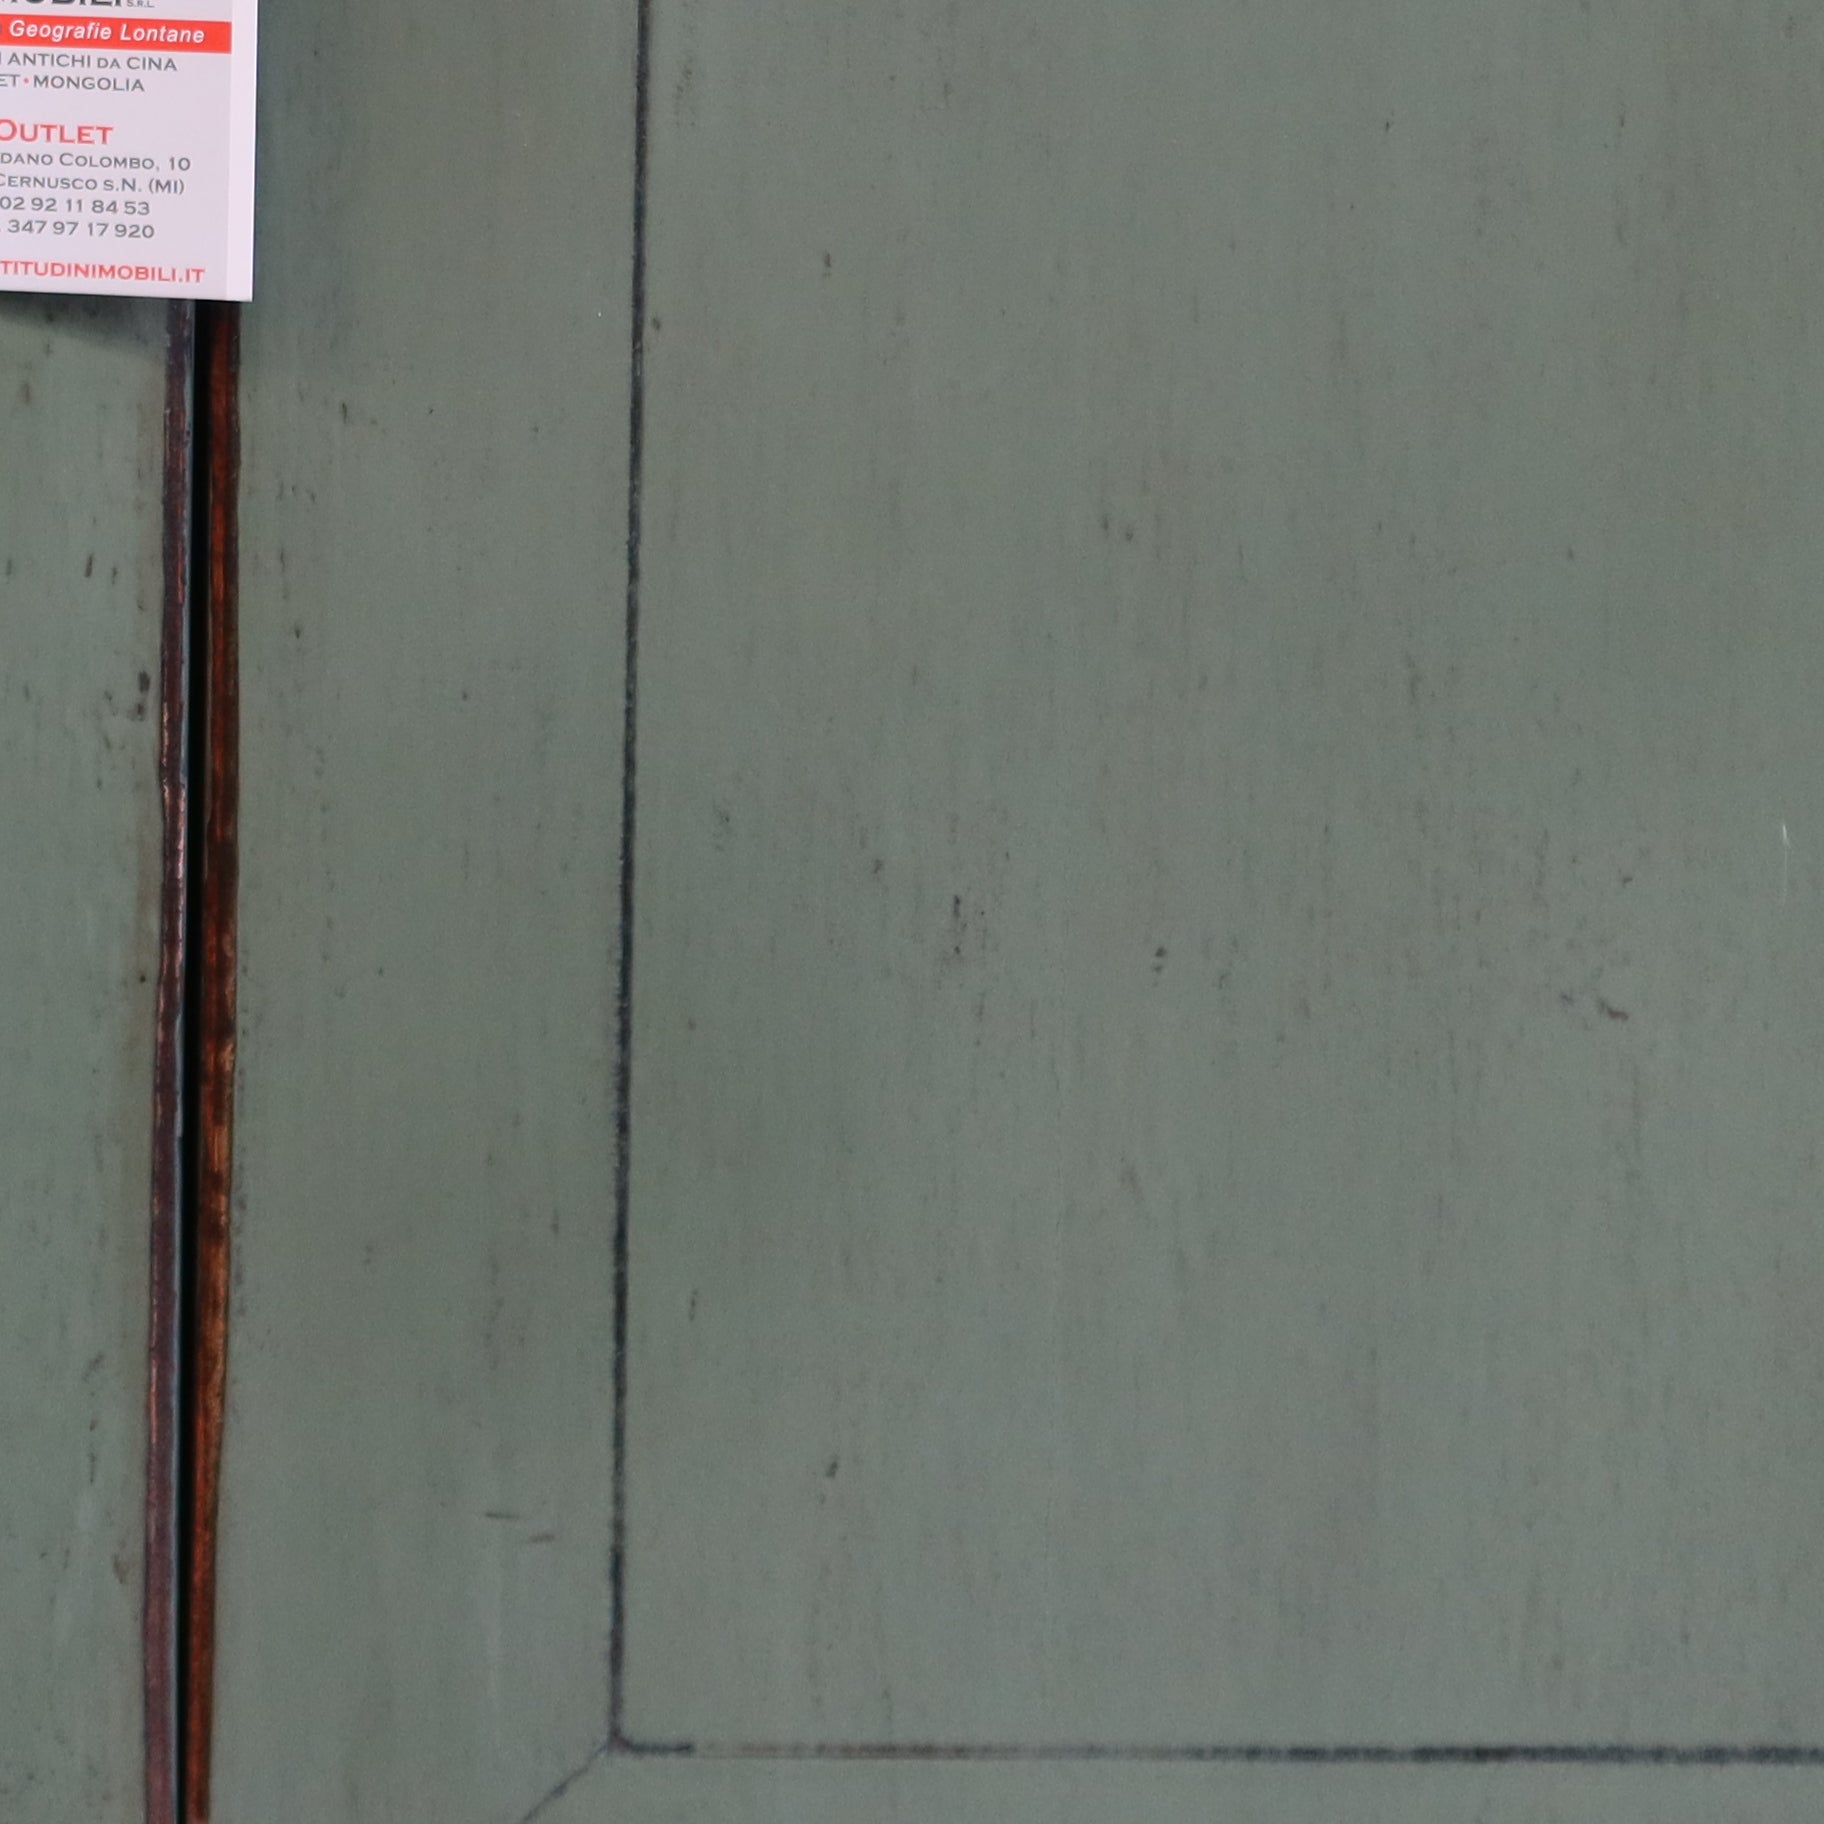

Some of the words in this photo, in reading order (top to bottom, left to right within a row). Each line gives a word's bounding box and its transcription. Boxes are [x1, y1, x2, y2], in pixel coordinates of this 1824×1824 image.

[9, 20, 112, 42] Geografie
[120, 23, 205, 44] Lontane
[7, 51, 91, 69] ANTICHI
[96, 57, 121, 70] DA
[126, 56, 178, 72] CINA
[33, 74, 145, 92] MONGOLIA
[169, 156, 191, 172] 10
[148, 177, 185, 195] (MI)
[30, 196, 58, 213] 92
[66, 198, 83, 213] 11
[91, 199, 119, 214] 84
[123, 200, 150, 216] 53
[7, 218, 48, 234] 347
[52, 220, 80, 236] 97
[87, 222, 110, 237] 17
[114, 223, 155, 239] 920
